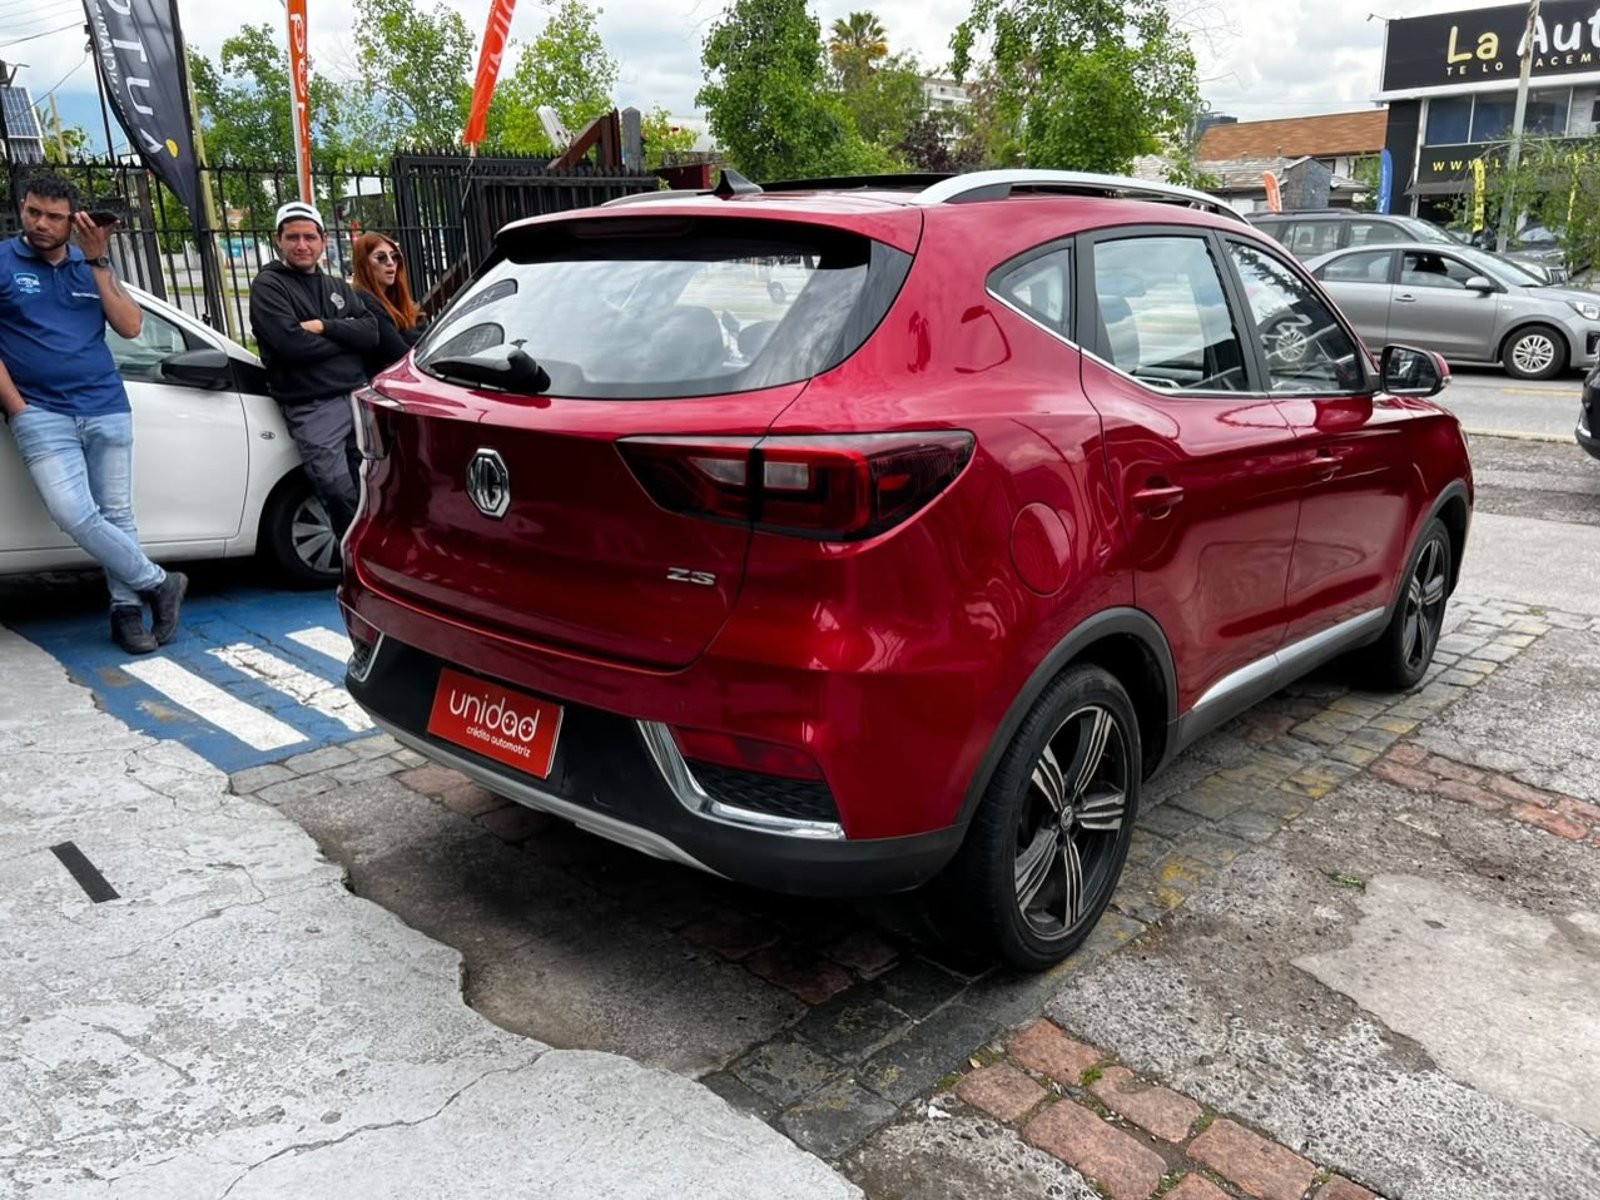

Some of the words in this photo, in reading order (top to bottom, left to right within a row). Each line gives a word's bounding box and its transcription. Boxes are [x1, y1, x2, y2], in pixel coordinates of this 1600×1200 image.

[1447, 26, 1499, 64] La
[1446, 65, 1467, 76] TE
[1482, 61, 1504, 73] LO
[667, 567, 716, 585] ZS
[450, 689, 540, 742] unidad
[491, 736, 531, 758] automotriz
